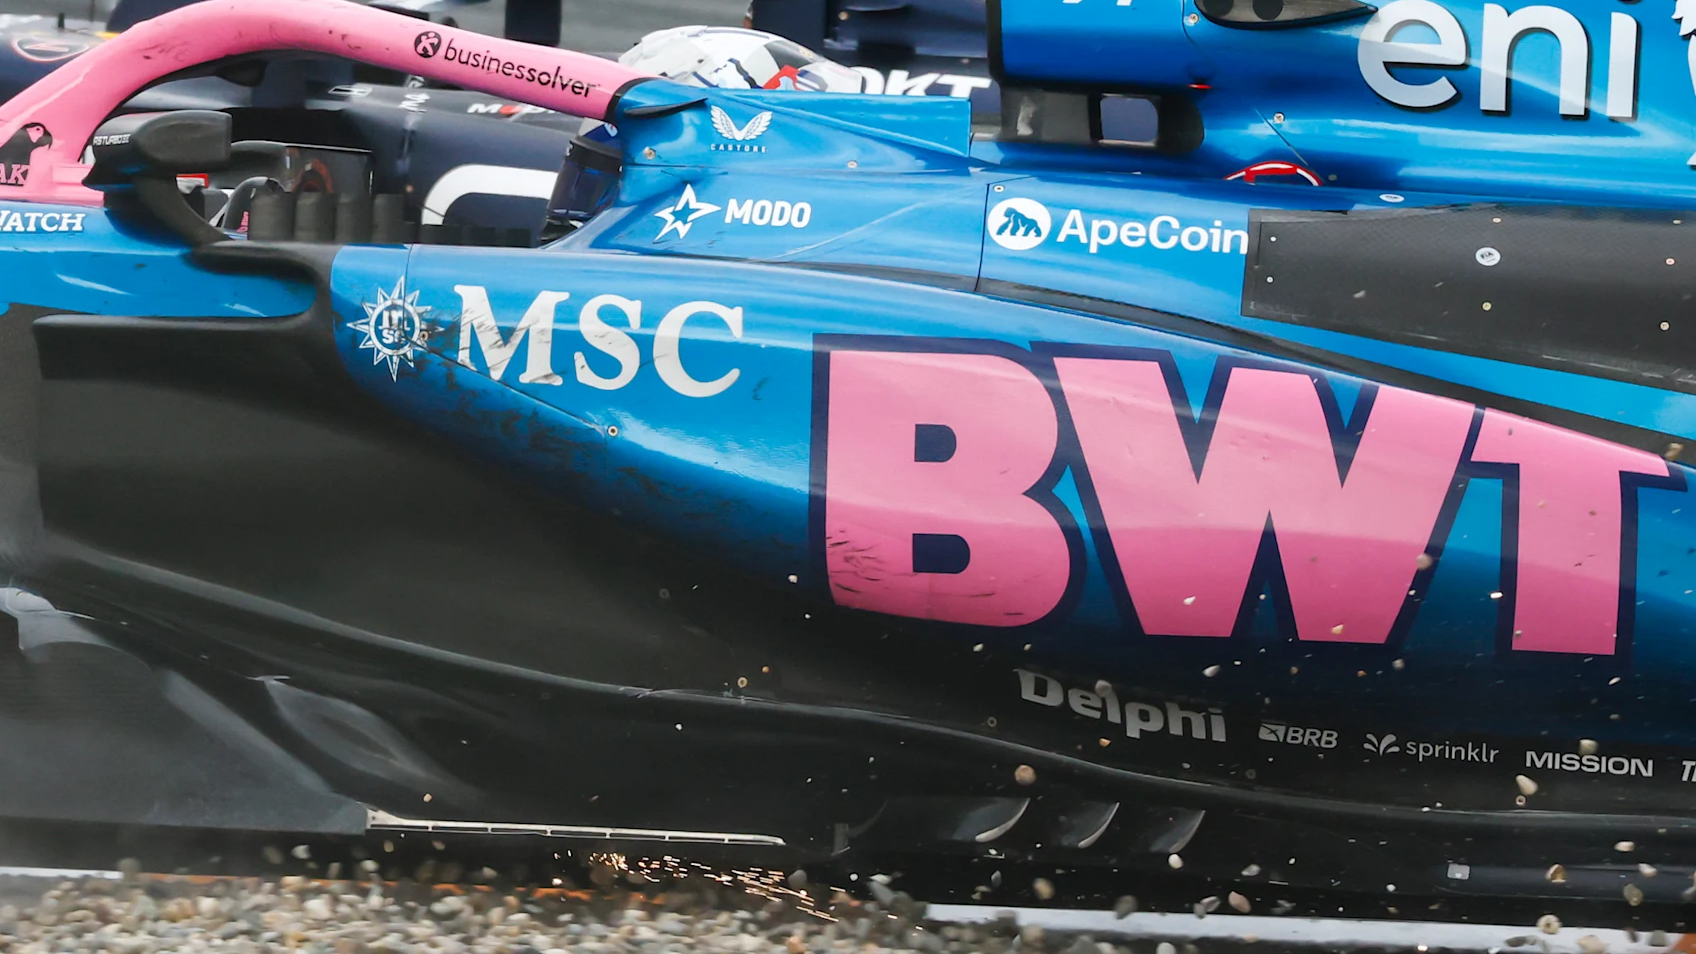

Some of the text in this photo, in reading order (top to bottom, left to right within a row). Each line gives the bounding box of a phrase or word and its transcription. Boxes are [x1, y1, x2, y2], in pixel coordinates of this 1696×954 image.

[444, 38, 593, 98] businessolver
[710, 143, 767, 153] CASTORE
[724, 198, 812, 229] MODO
[1056, 208, 1249, 255] ApeCoin
[453, 284, 744, 398] MSC
[824, 348, 1670, 657] BWT
[1013, 668, 1227, 743] Delphi
[1285, 727, 1339, 749] BRB
[1405, 740, 1500, 764] sprinklr
[1525, 750, 1654, 778] MISSION
